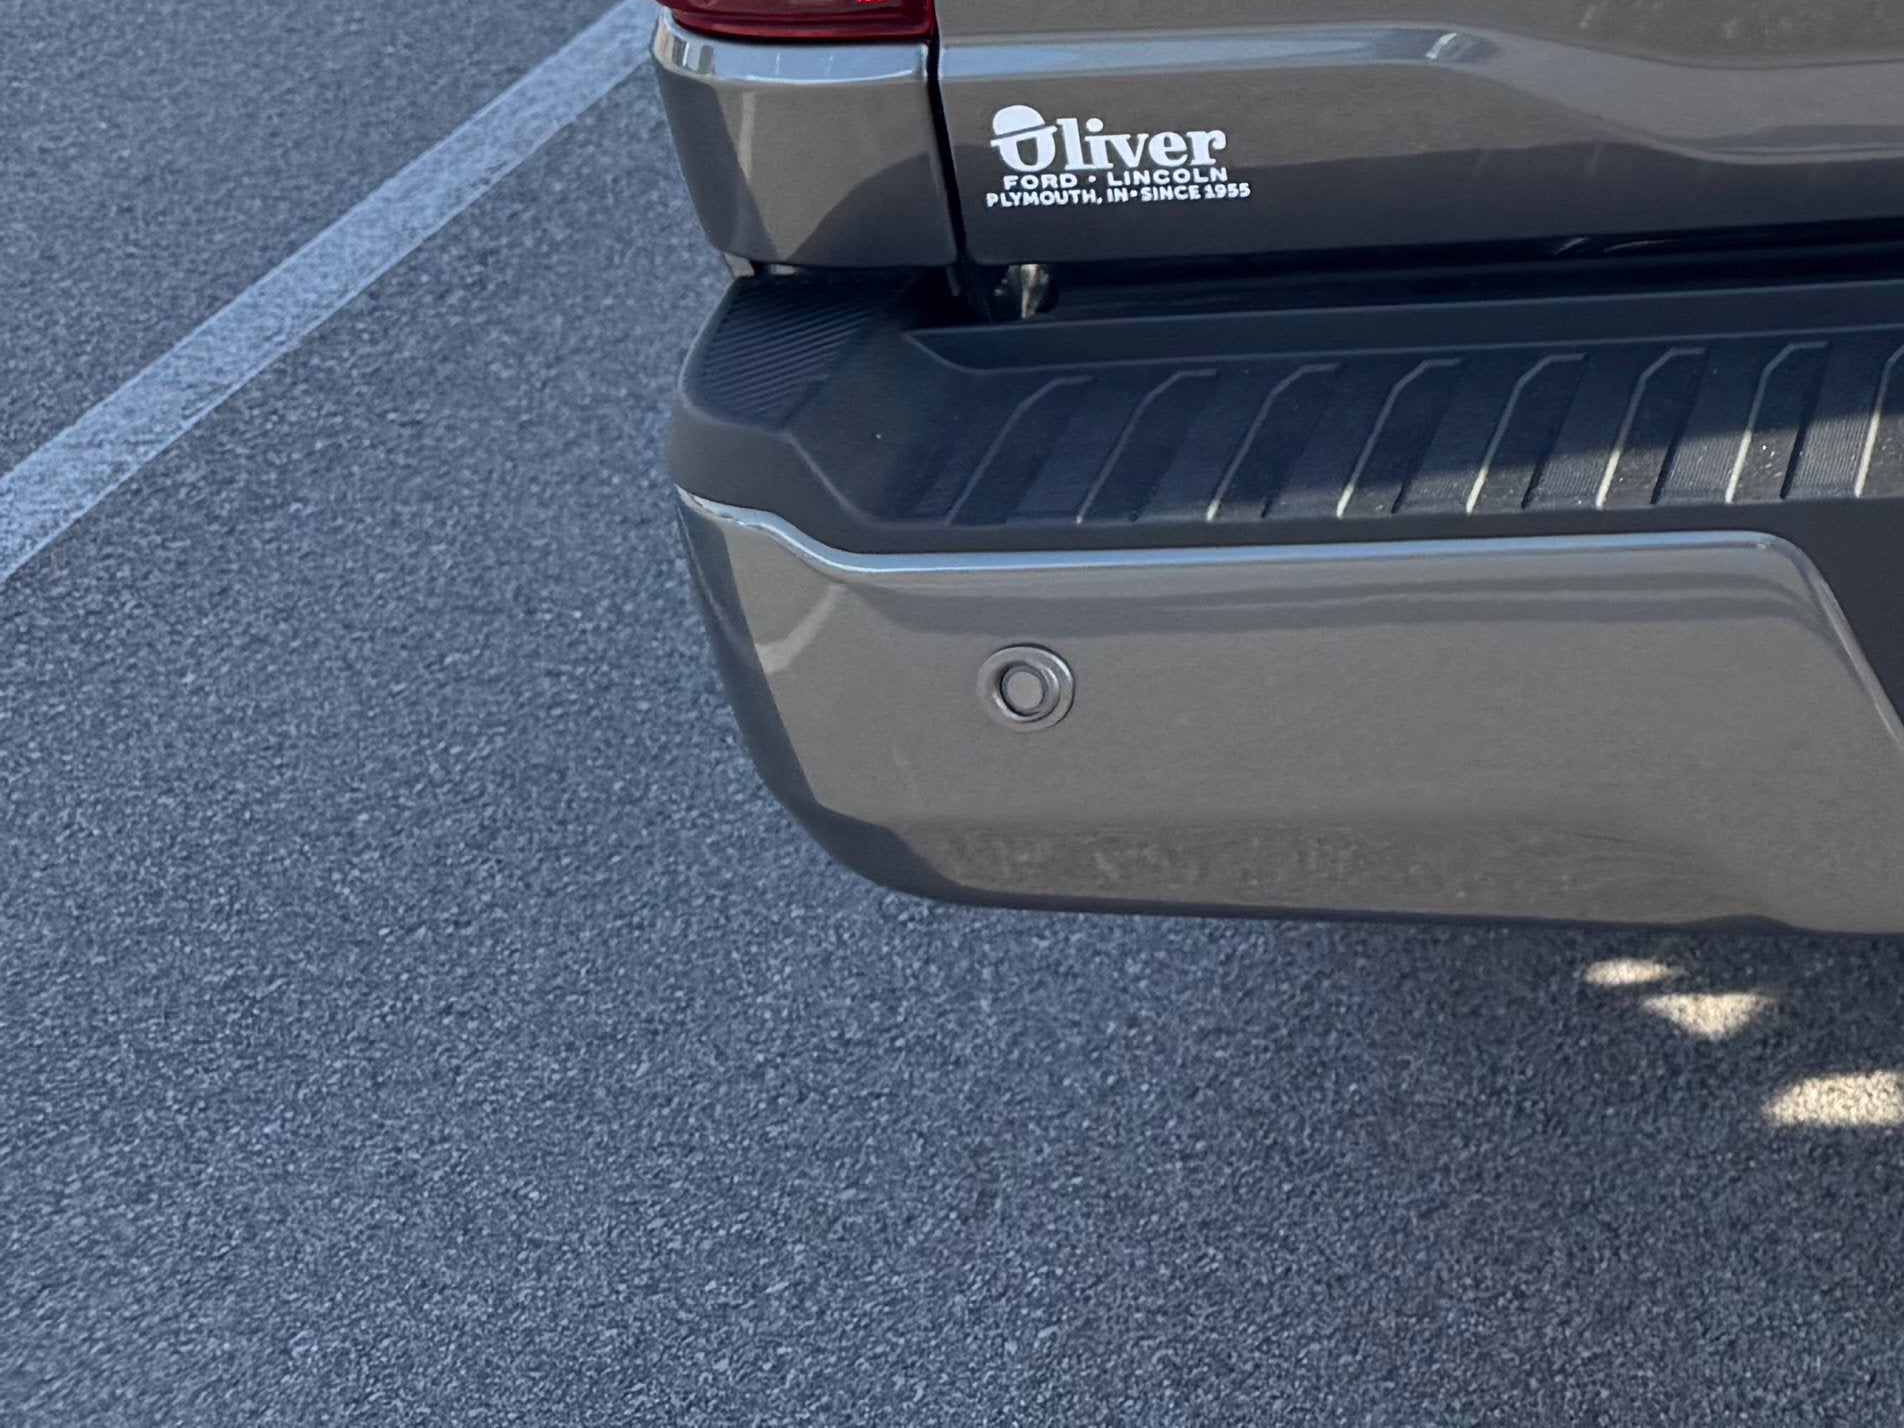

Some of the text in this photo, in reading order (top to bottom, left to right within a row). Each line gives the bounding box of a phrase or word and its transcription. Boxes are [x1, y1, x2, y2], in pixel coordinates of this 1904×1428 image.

[990, 104, 1227, 172] Oliver
[1003, 167, 1228, 190] FORD LINCOLN
[986, 188, 1103, 207] PLYMOUTH,
[1204, 182, 1251, 200] 1955
